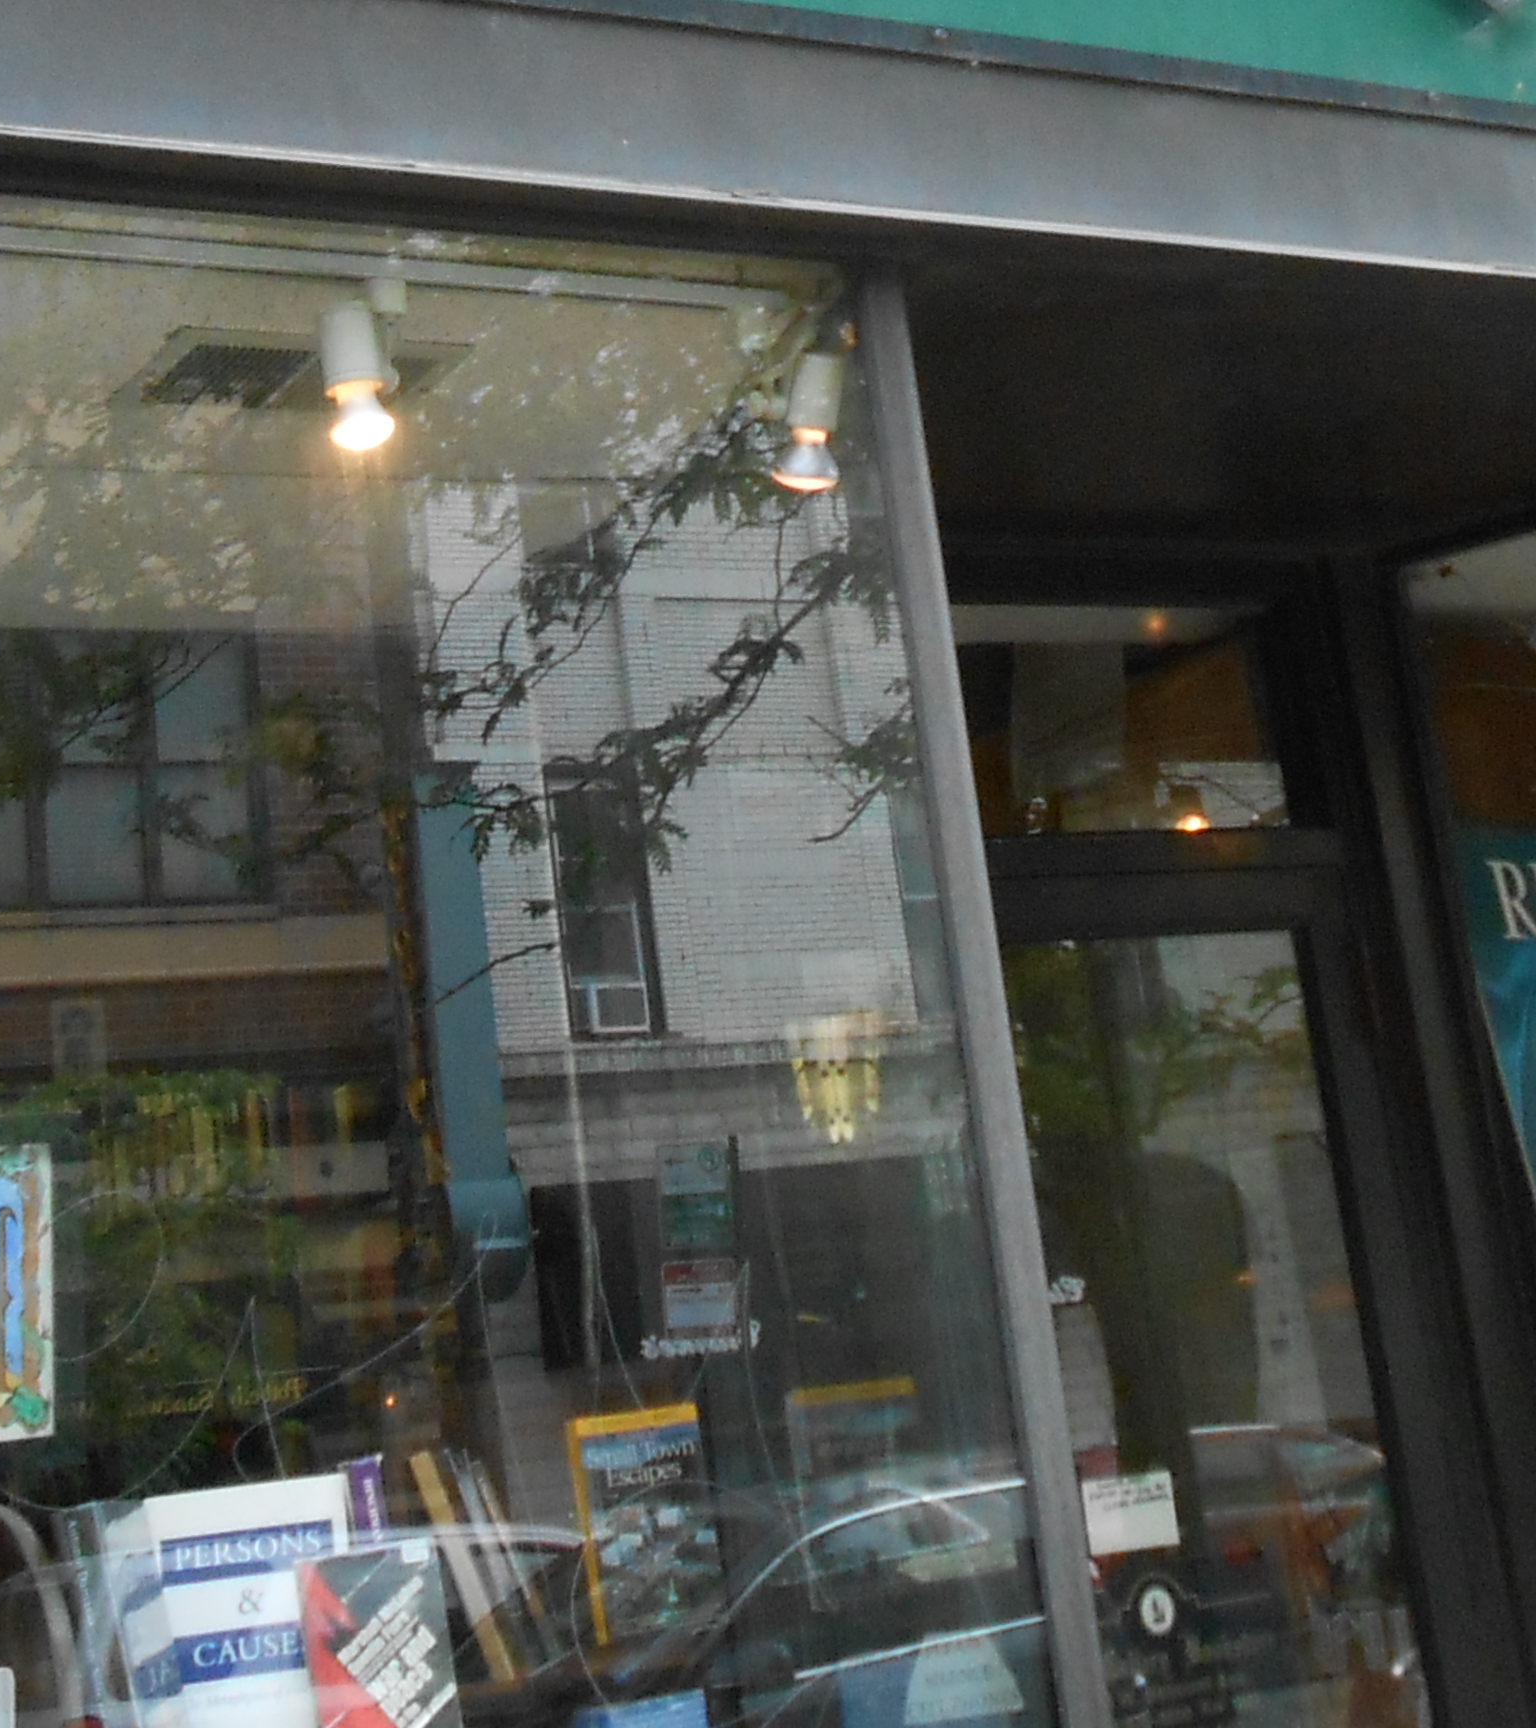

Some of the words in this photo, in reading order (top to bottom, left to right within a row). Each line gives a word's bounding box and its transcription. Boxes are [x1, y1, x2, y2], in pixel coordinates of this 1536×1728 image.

[605, 1463, 683, 1489] Escapes
[175, 1528, 322, 1571] PERSONS
[238, 1588, 264, 1615] &
